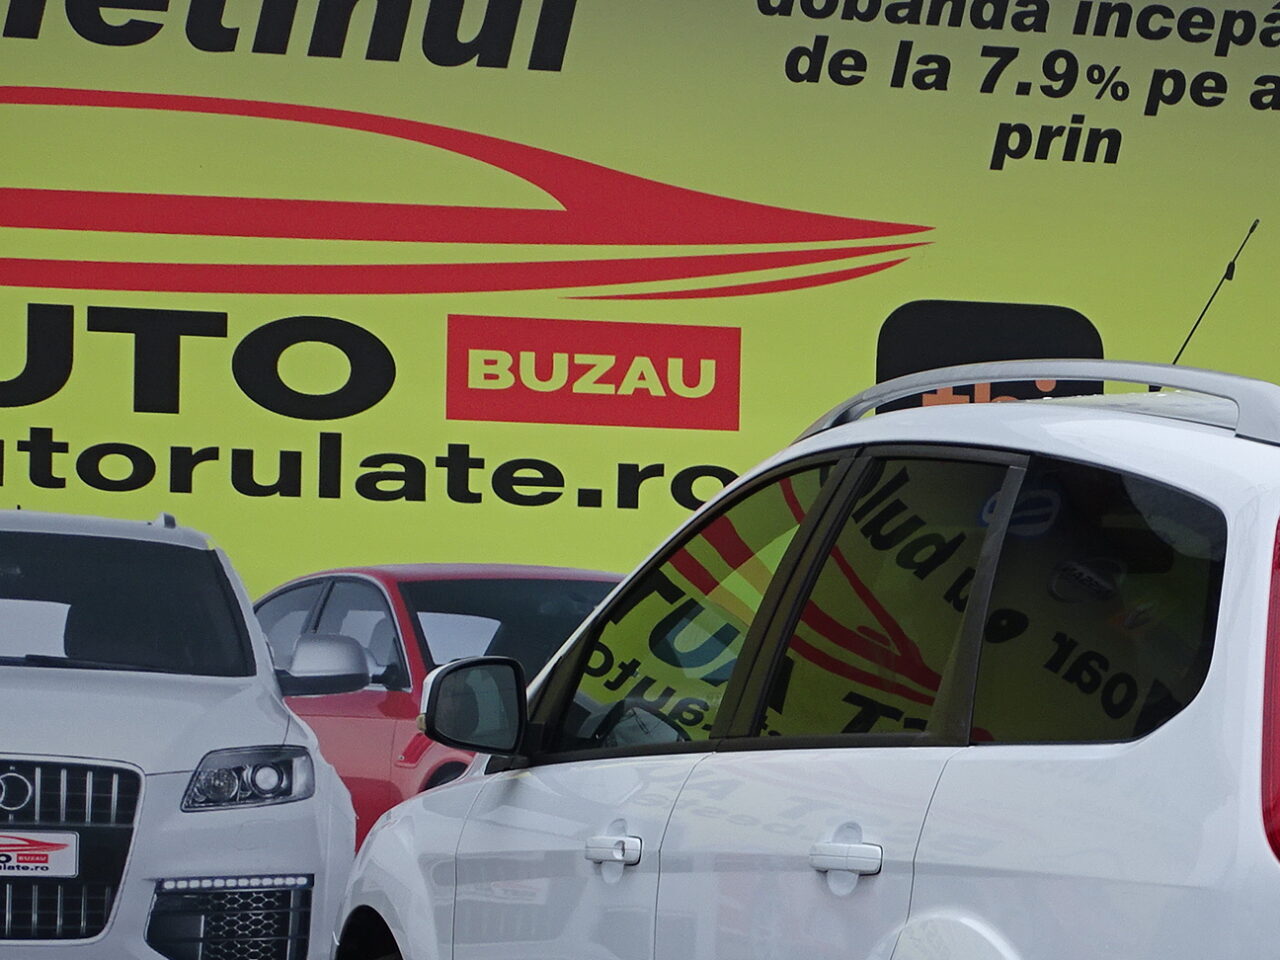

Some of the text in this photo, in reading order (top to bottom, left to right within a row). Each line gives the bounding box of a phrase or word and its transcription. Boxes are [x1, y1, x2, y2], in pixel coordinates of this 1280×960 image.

[785, 35, 868, 86] de
[890, 40, 951, 91] la
[979, 45, 1130, 102] 7.9%
[1144, 68, 1228, 116] pe
[989, 114, 1123, 171] prin
[468, 349, 716, 398] BUZAU
[0, 427, 738, 512] torulate.ro
